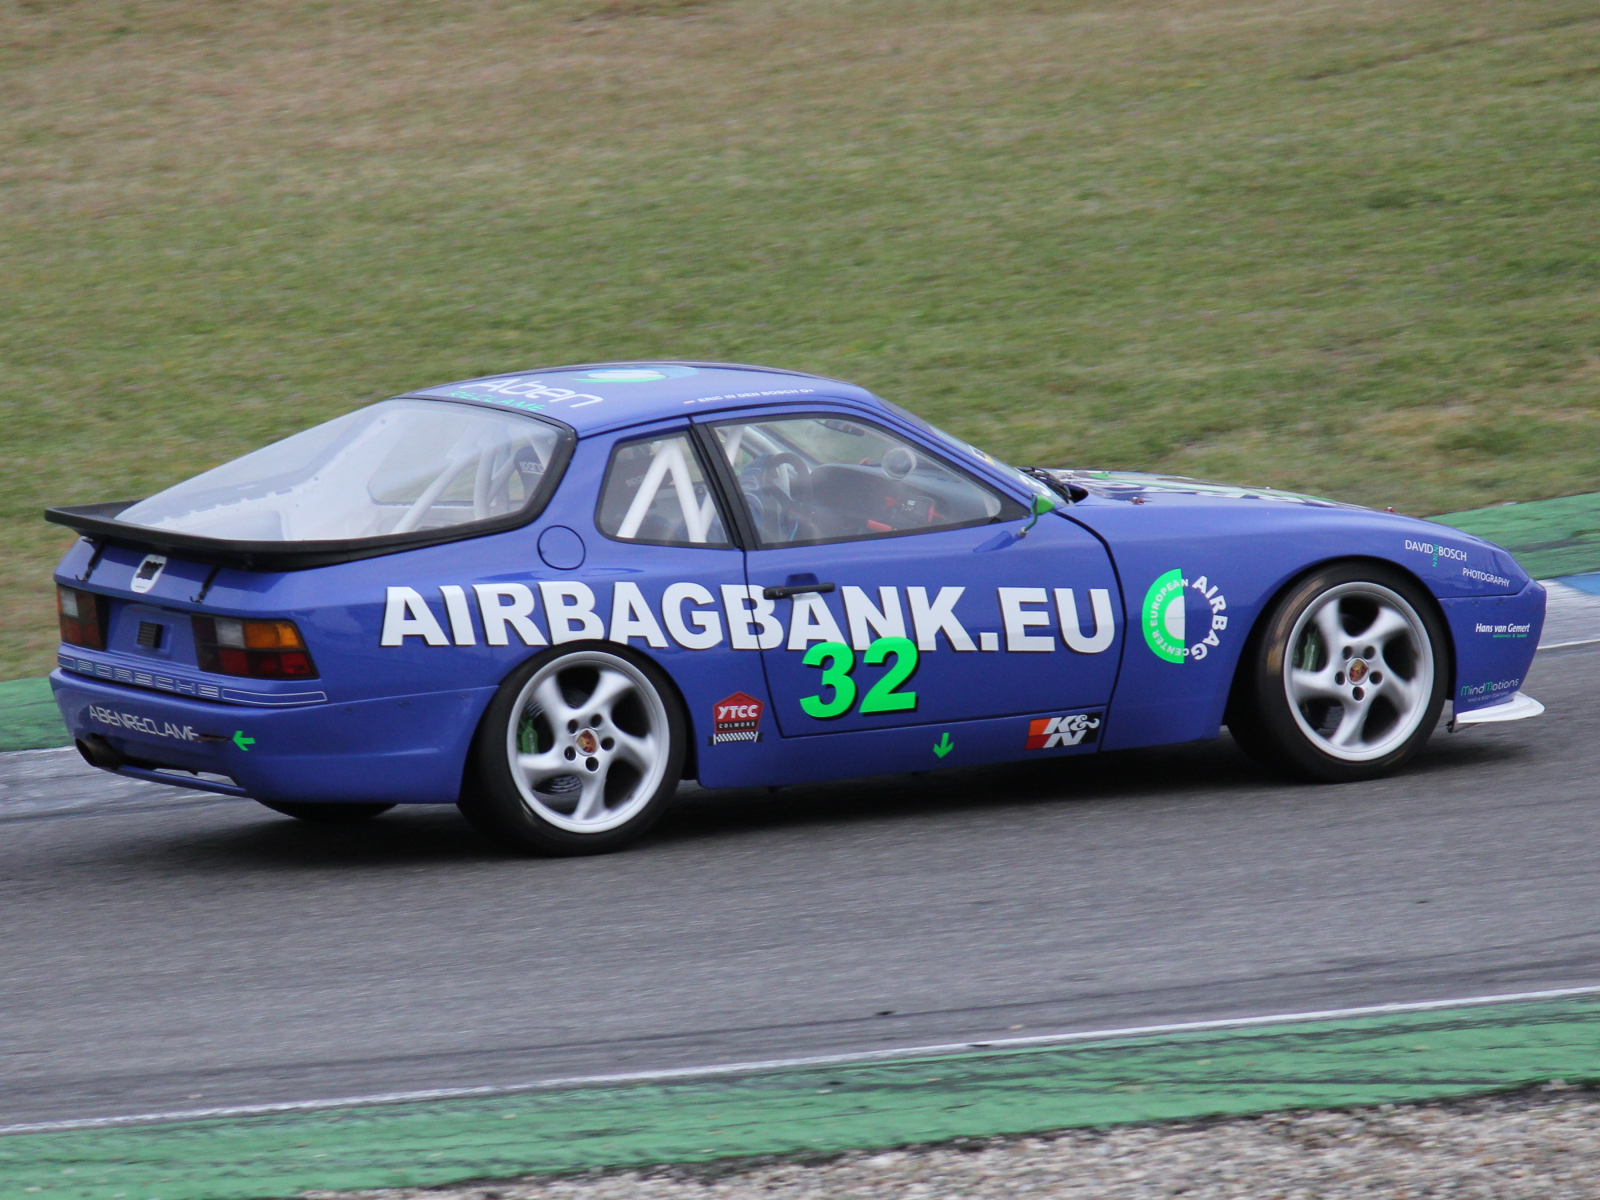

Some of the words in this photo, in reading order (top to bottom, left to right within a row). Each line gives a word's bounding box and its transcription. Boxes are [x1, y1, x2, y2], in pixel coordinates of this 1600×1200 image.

[459, 378, 604, 408] Aben
[1405, 539, 1434, 554] DAVID
[1438, 546, 1468, 562] BOSCH
[1462, 567, 1511, 588] PHOTOGRAPHY
[1150, 578, 1189, 627] EUROPEAN
[380, 581, 1115, 655] AIRBAGBANK.EU
[1191, 575, 1229, 661] AIRBAG
[1475, 622, 1494, 633] Hans
[1494, 625, 1507, 633] van
[1507, 622, 1531, 633] Gemert
[1151, 629, 1190, 657] CENTER
[77, 659, 219, 698] PORSCHE
[799, 636, 919, 719] 32
[1461, 678, 1520, 696] MindMotions
[717, 704, 759, 720] YTCC
[718, 721, 756, 729] COLMORE
